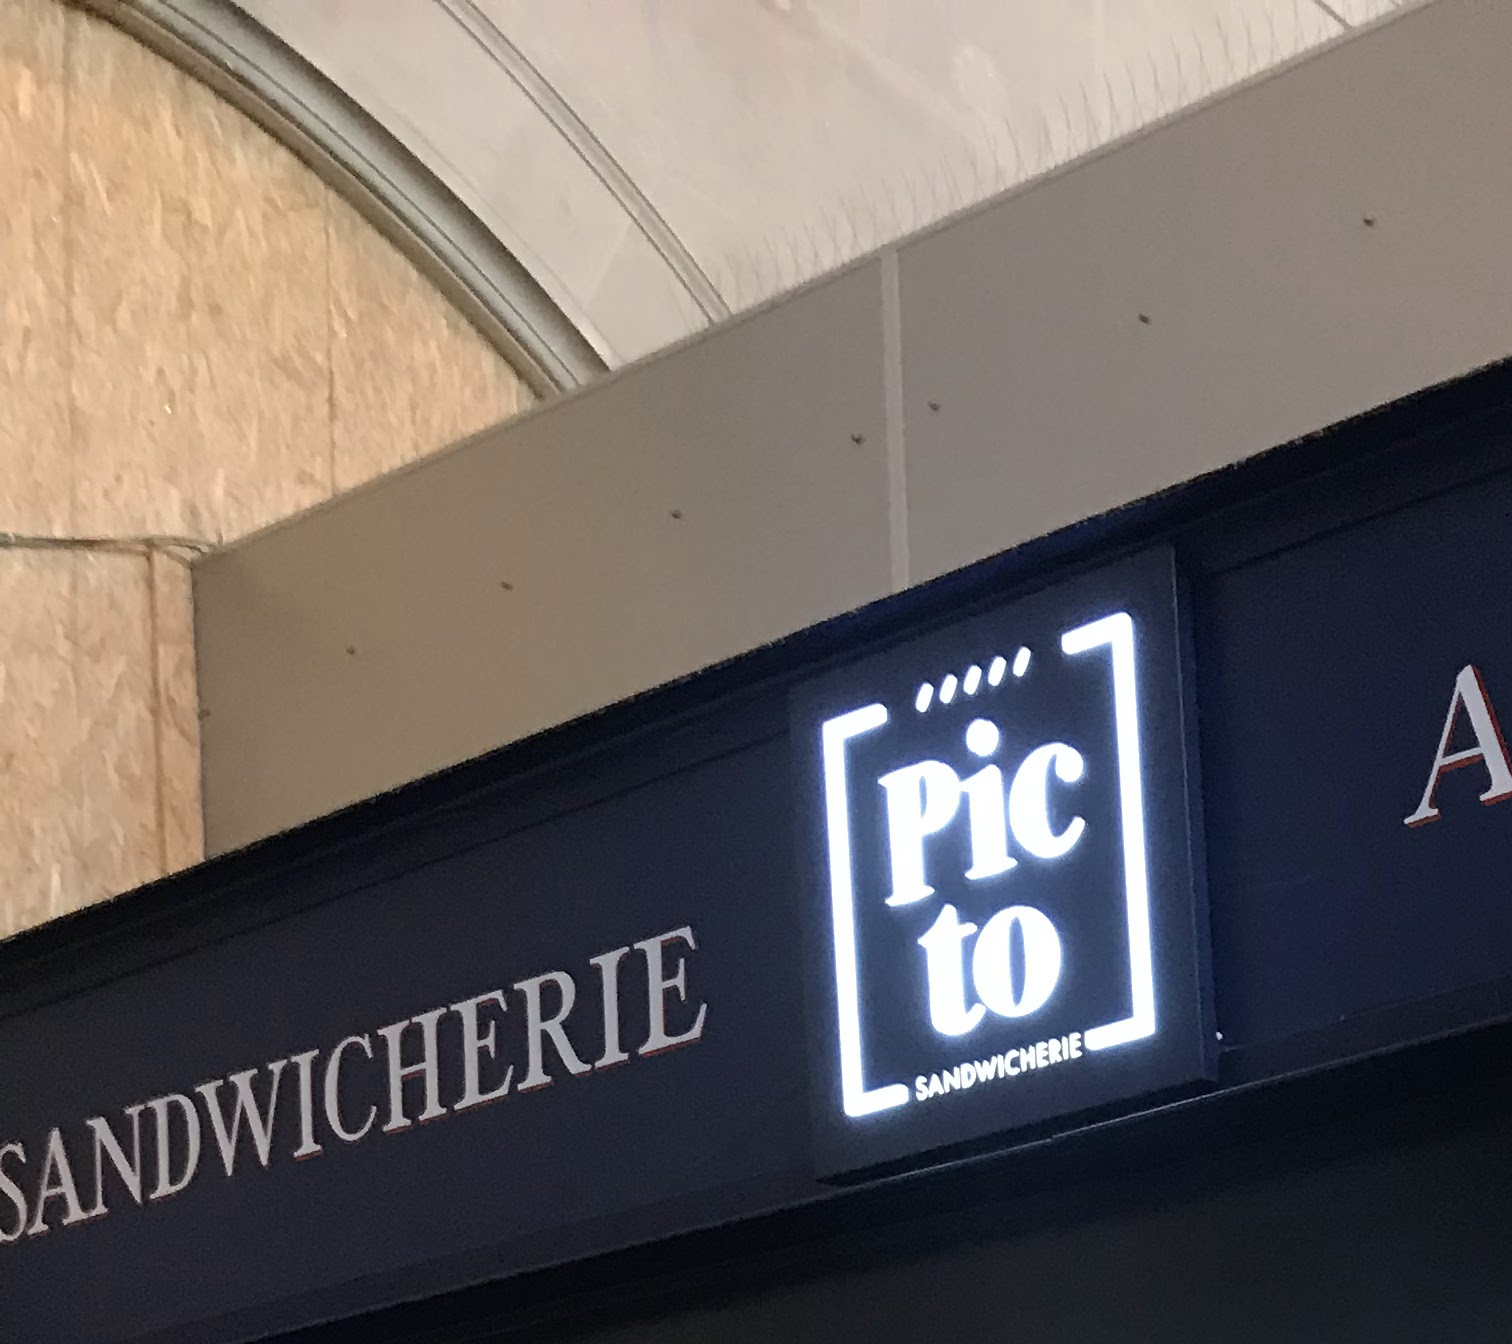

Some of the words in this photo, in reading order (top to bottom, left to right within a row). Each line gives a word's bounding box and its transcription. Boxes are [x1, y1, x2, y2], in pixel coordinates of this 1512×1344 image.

[878, 719, 1085, 906] Pic
[918, 903, 1061, 1036] to
[0, 925, 708, 1243] SANDWICHERIE
[915, 1031, 1082, 1100] SANDWICHERIE
